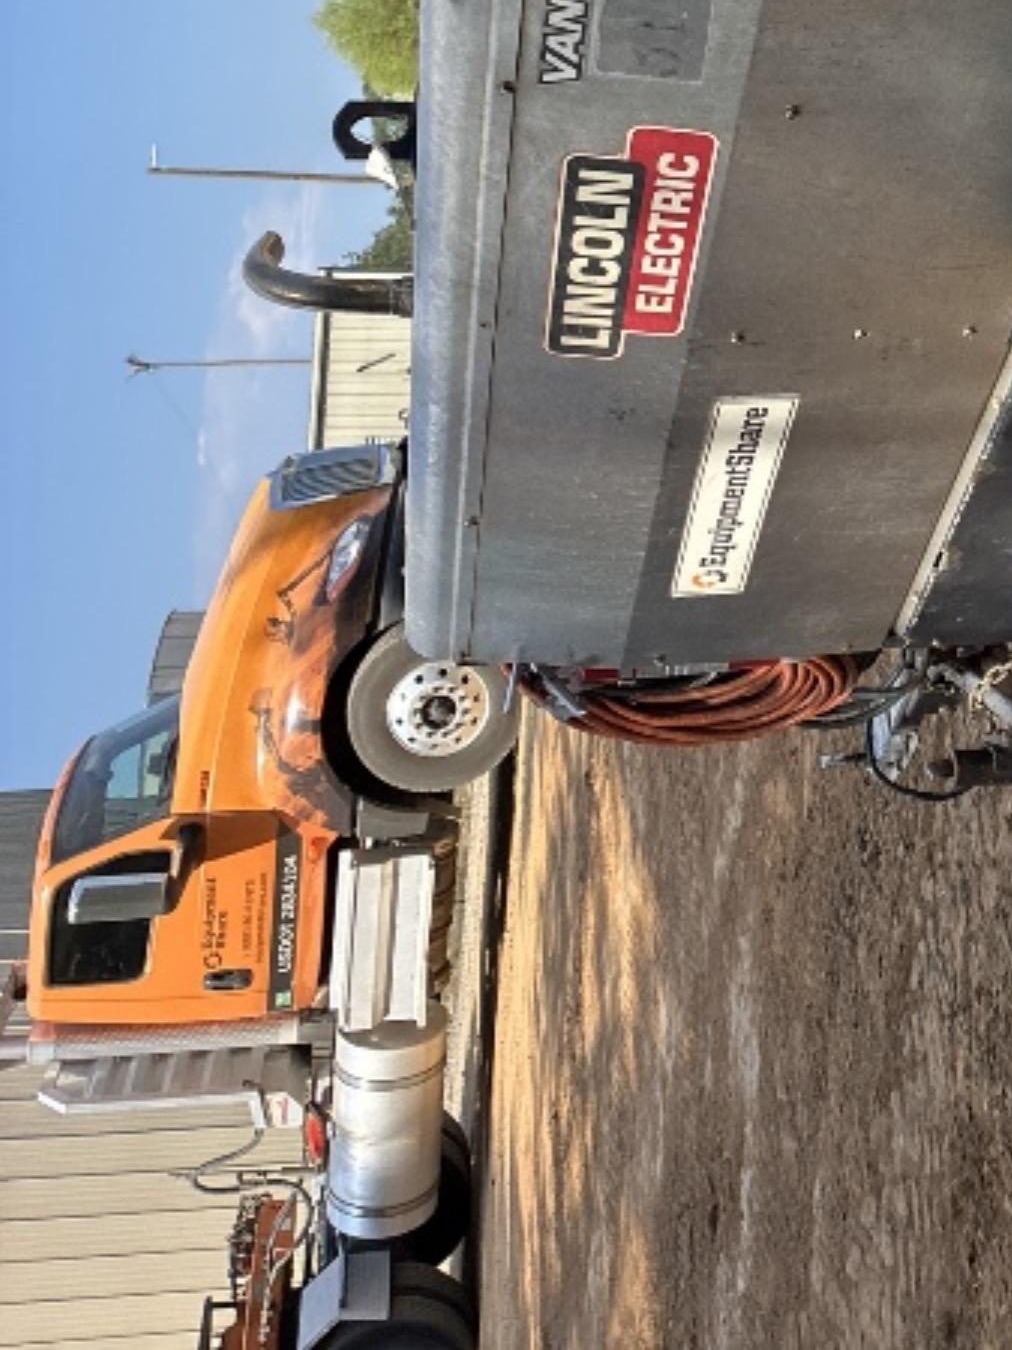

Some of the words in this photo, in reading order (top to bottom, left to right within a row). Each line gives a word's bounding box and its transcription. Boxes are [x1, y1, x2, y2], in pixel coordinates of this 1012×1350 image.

[560, 169, 634, 349] LINCOLN
[635, 152, 700, 314] ELECTRIC
[698, 407, 769, 567] EquipmentShare
